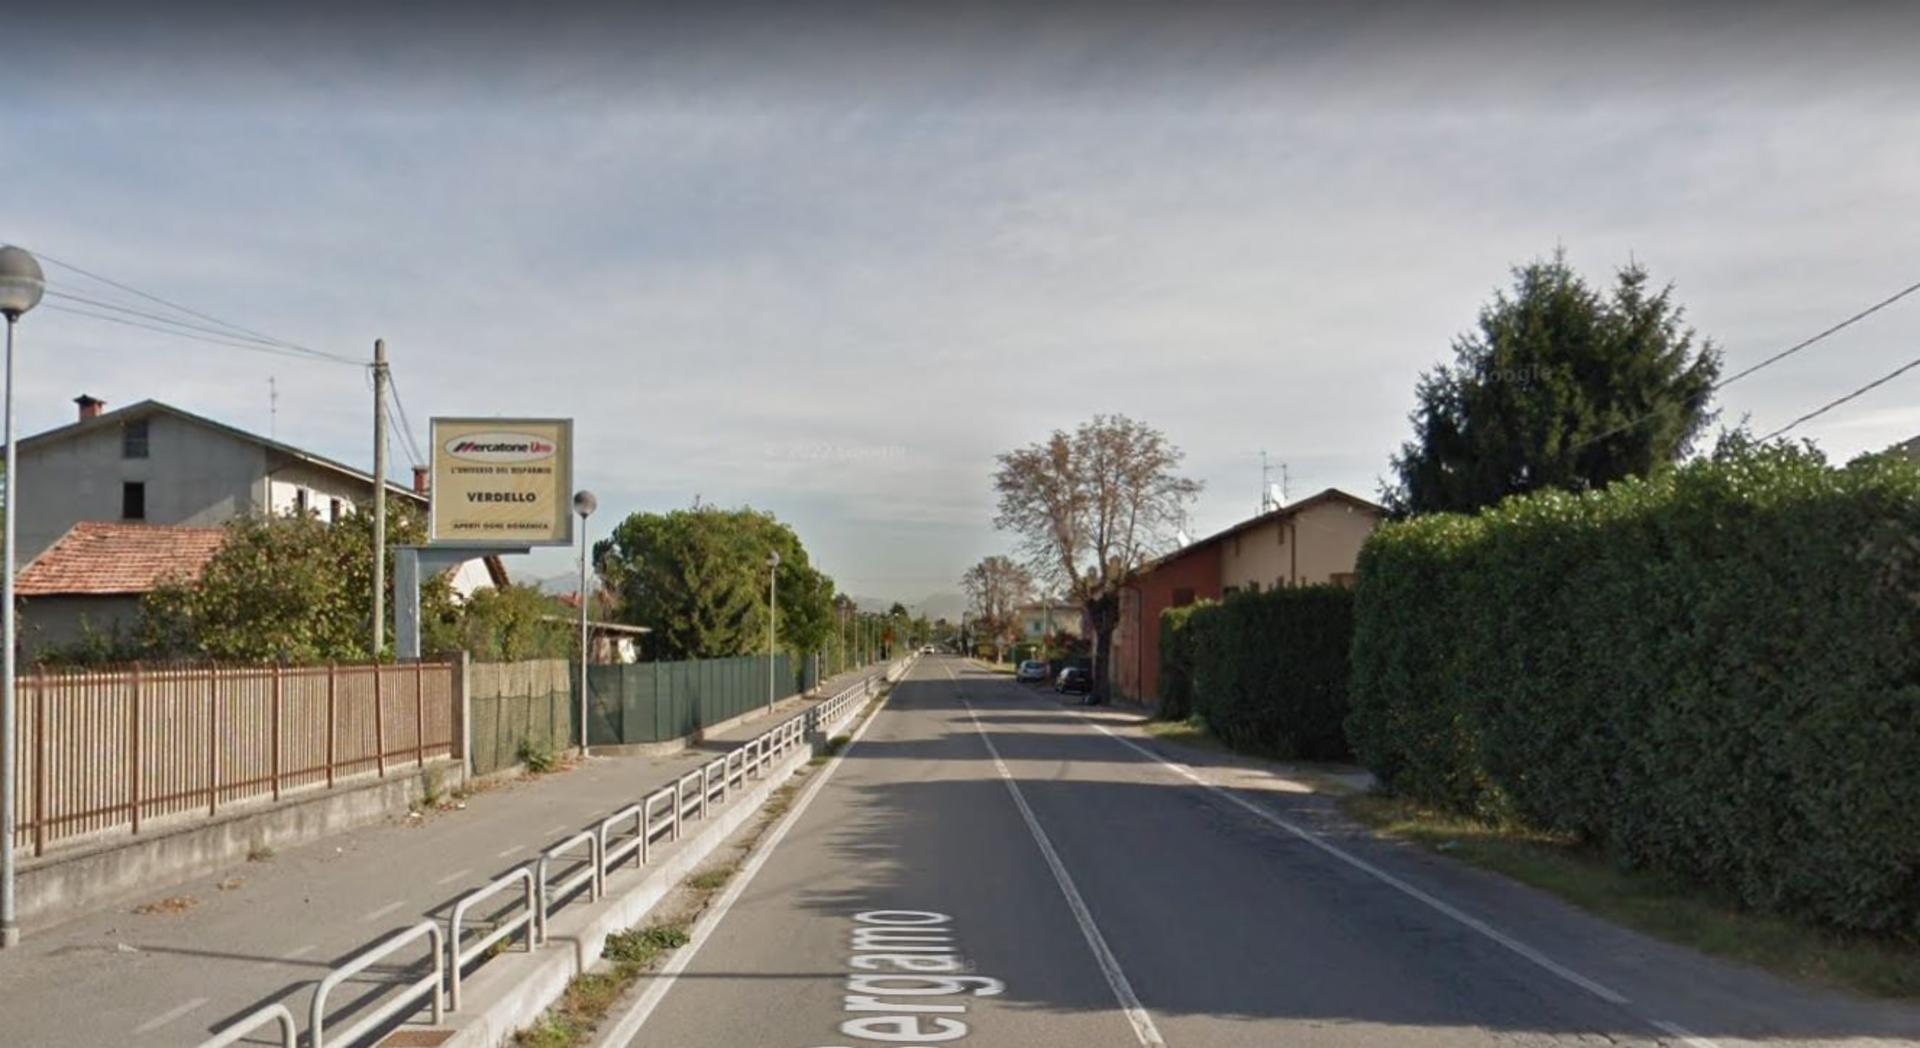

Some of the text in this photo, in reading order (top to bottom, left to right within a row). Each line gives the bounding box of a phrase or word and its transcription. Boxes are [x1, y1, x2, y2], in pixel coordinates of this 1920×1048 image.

[453, 441, 553, 453] Mercatone Uno
[495, 466, 509, 475] DEL
[510, 466, 552, 475] RISPARMIO
[467, 492, 537, 502] VERDELLO
